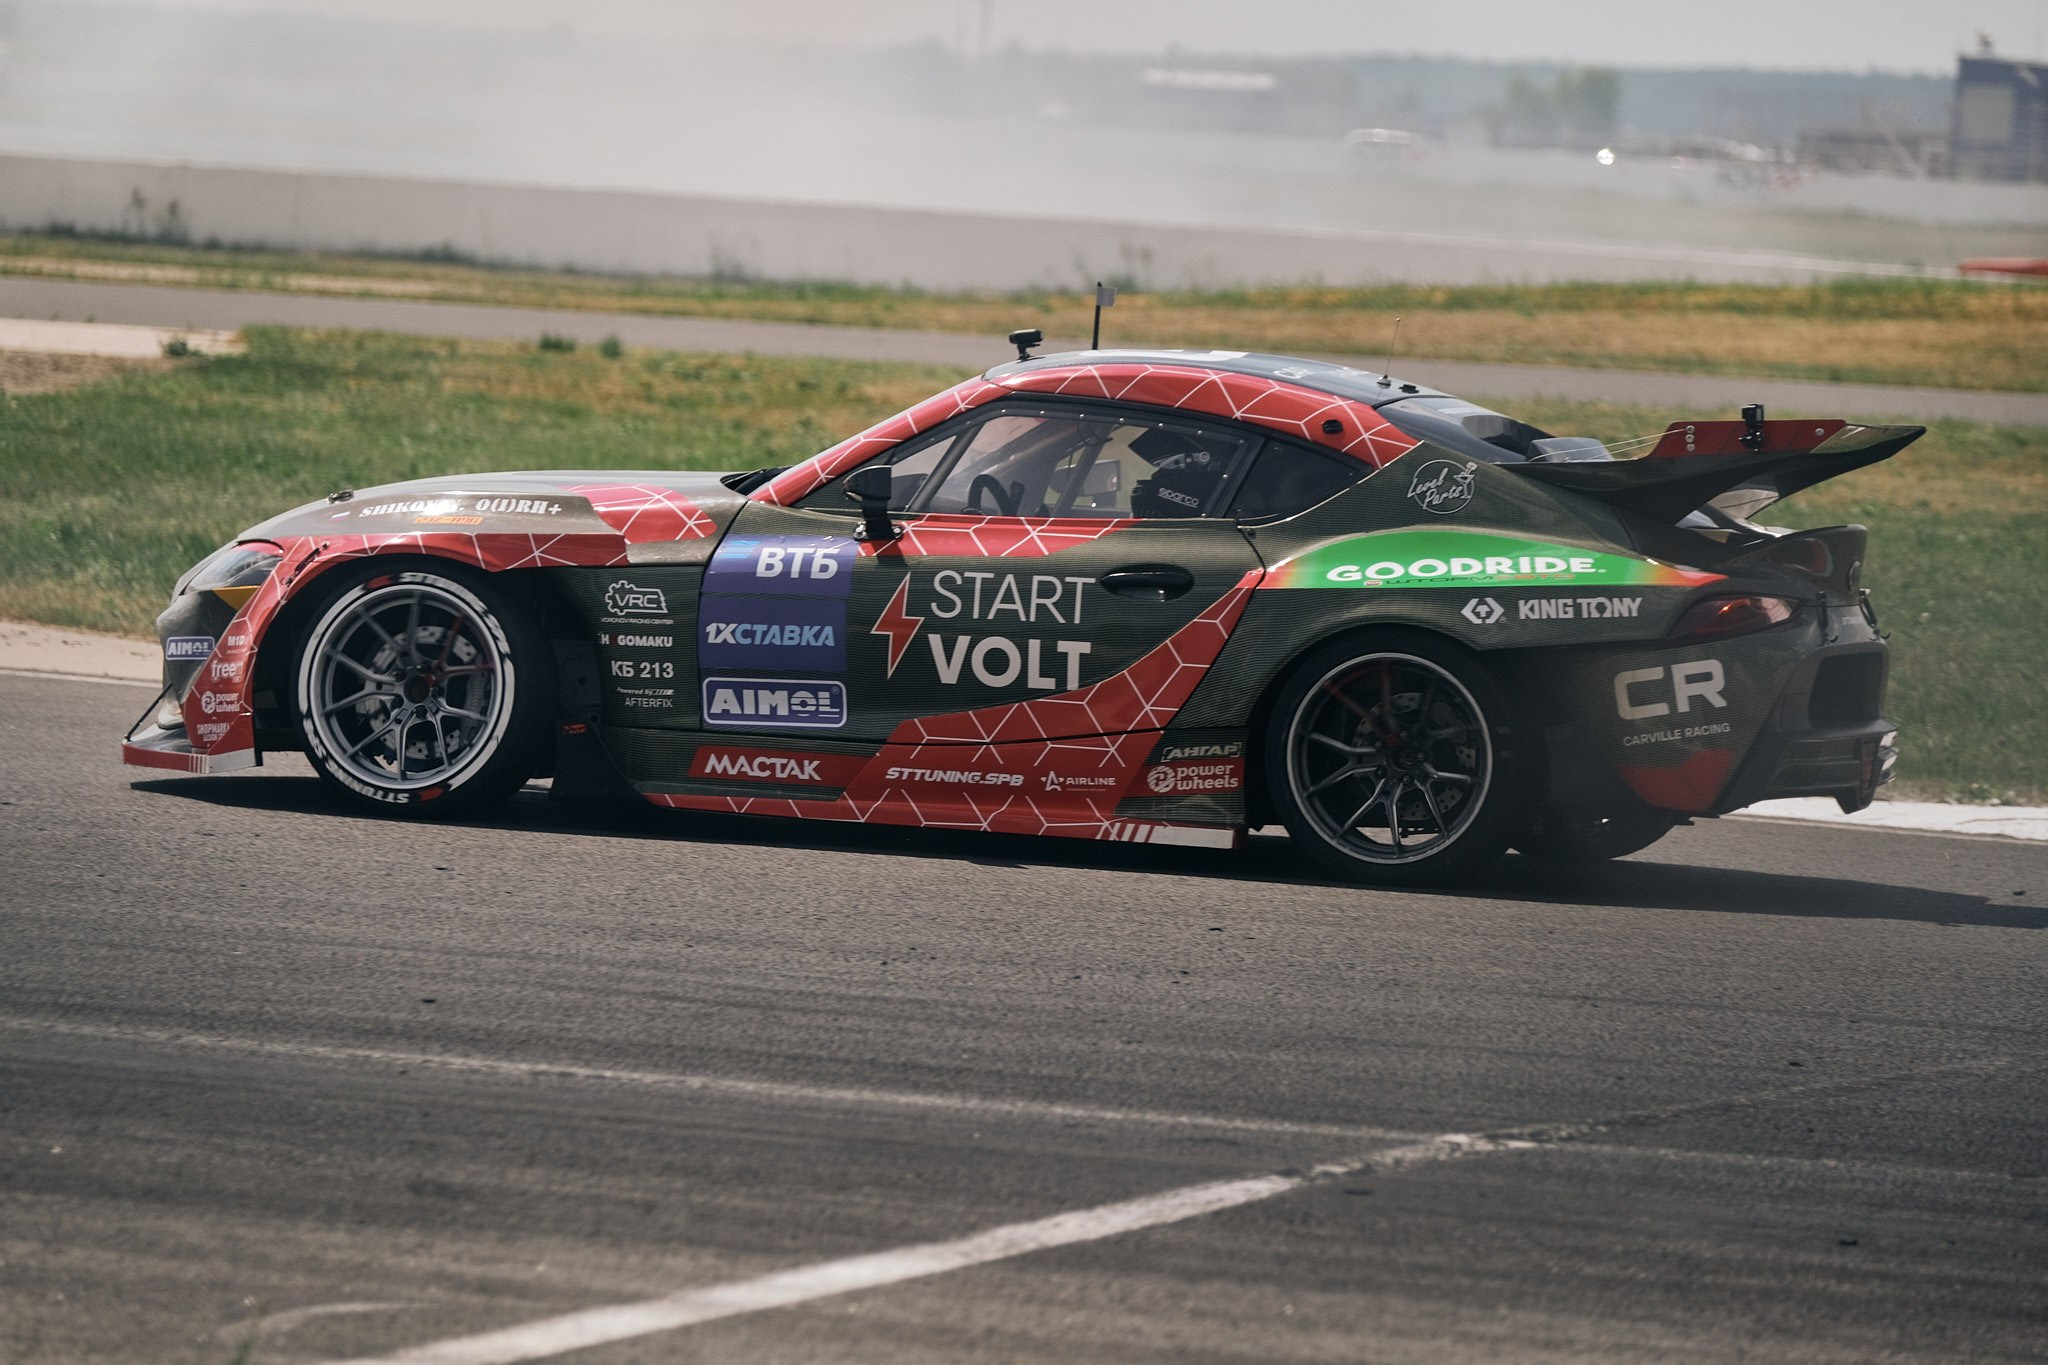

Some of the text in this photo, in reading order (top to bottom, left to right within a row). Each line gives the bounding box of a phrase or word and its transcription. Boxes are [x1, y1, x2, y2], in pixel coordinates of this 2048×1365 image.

[1407, 467, 1448, 497] Level
[1158, 487, 1199, 507] sparco
[756, 547, 841, 579] ВТБ
[1326, 557, 1598, 581] GOODRIDE
[615, 593, 658, 607] VRC
[931, 570, 1096, 624] START
[1518, 597, 1642, 620] KING TONY
[167, 641, 213, 656] AIMOL
[611, 661, 674, 678] КБ 213
[927, 634, 1091, 691] VOLT
[1613, 659, 1728, 720] CR
[625, 698, 673, 708] AFTERFIX
[709, 688, 841, 718] AIMOL
[1623, 722, 1731, 747] CARVILLE RACING
[885, 767, 1025, 787] STTUNING.SPB
[1065, 776, 1117, 786] AIRLINE
[1176, 764, 1235, 781] power
[1176, 775, 1239, 790] wheels
